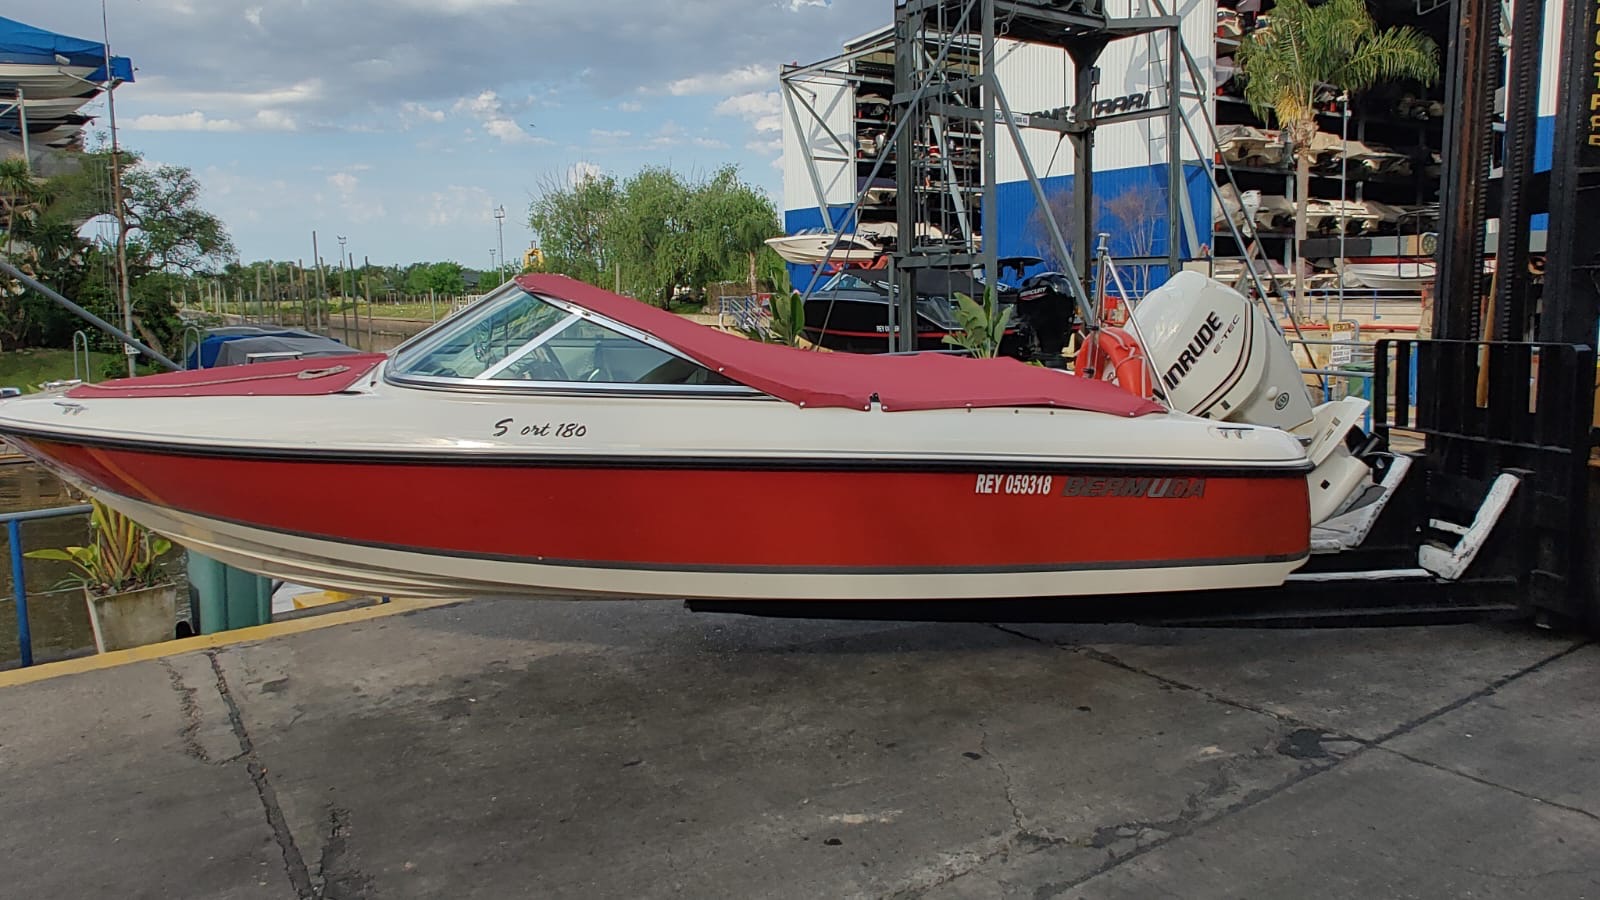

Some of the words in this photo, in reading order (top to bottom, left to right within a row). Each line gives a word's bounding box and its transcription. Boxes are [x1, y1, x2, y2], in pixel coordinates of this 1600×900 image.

[555, 422, 587, 438] 180
[975, 473, 1003, 494] REY
[1005, 474, 1052, 495] 059318
[1062, 476, 1207, 498] BERMUDA
